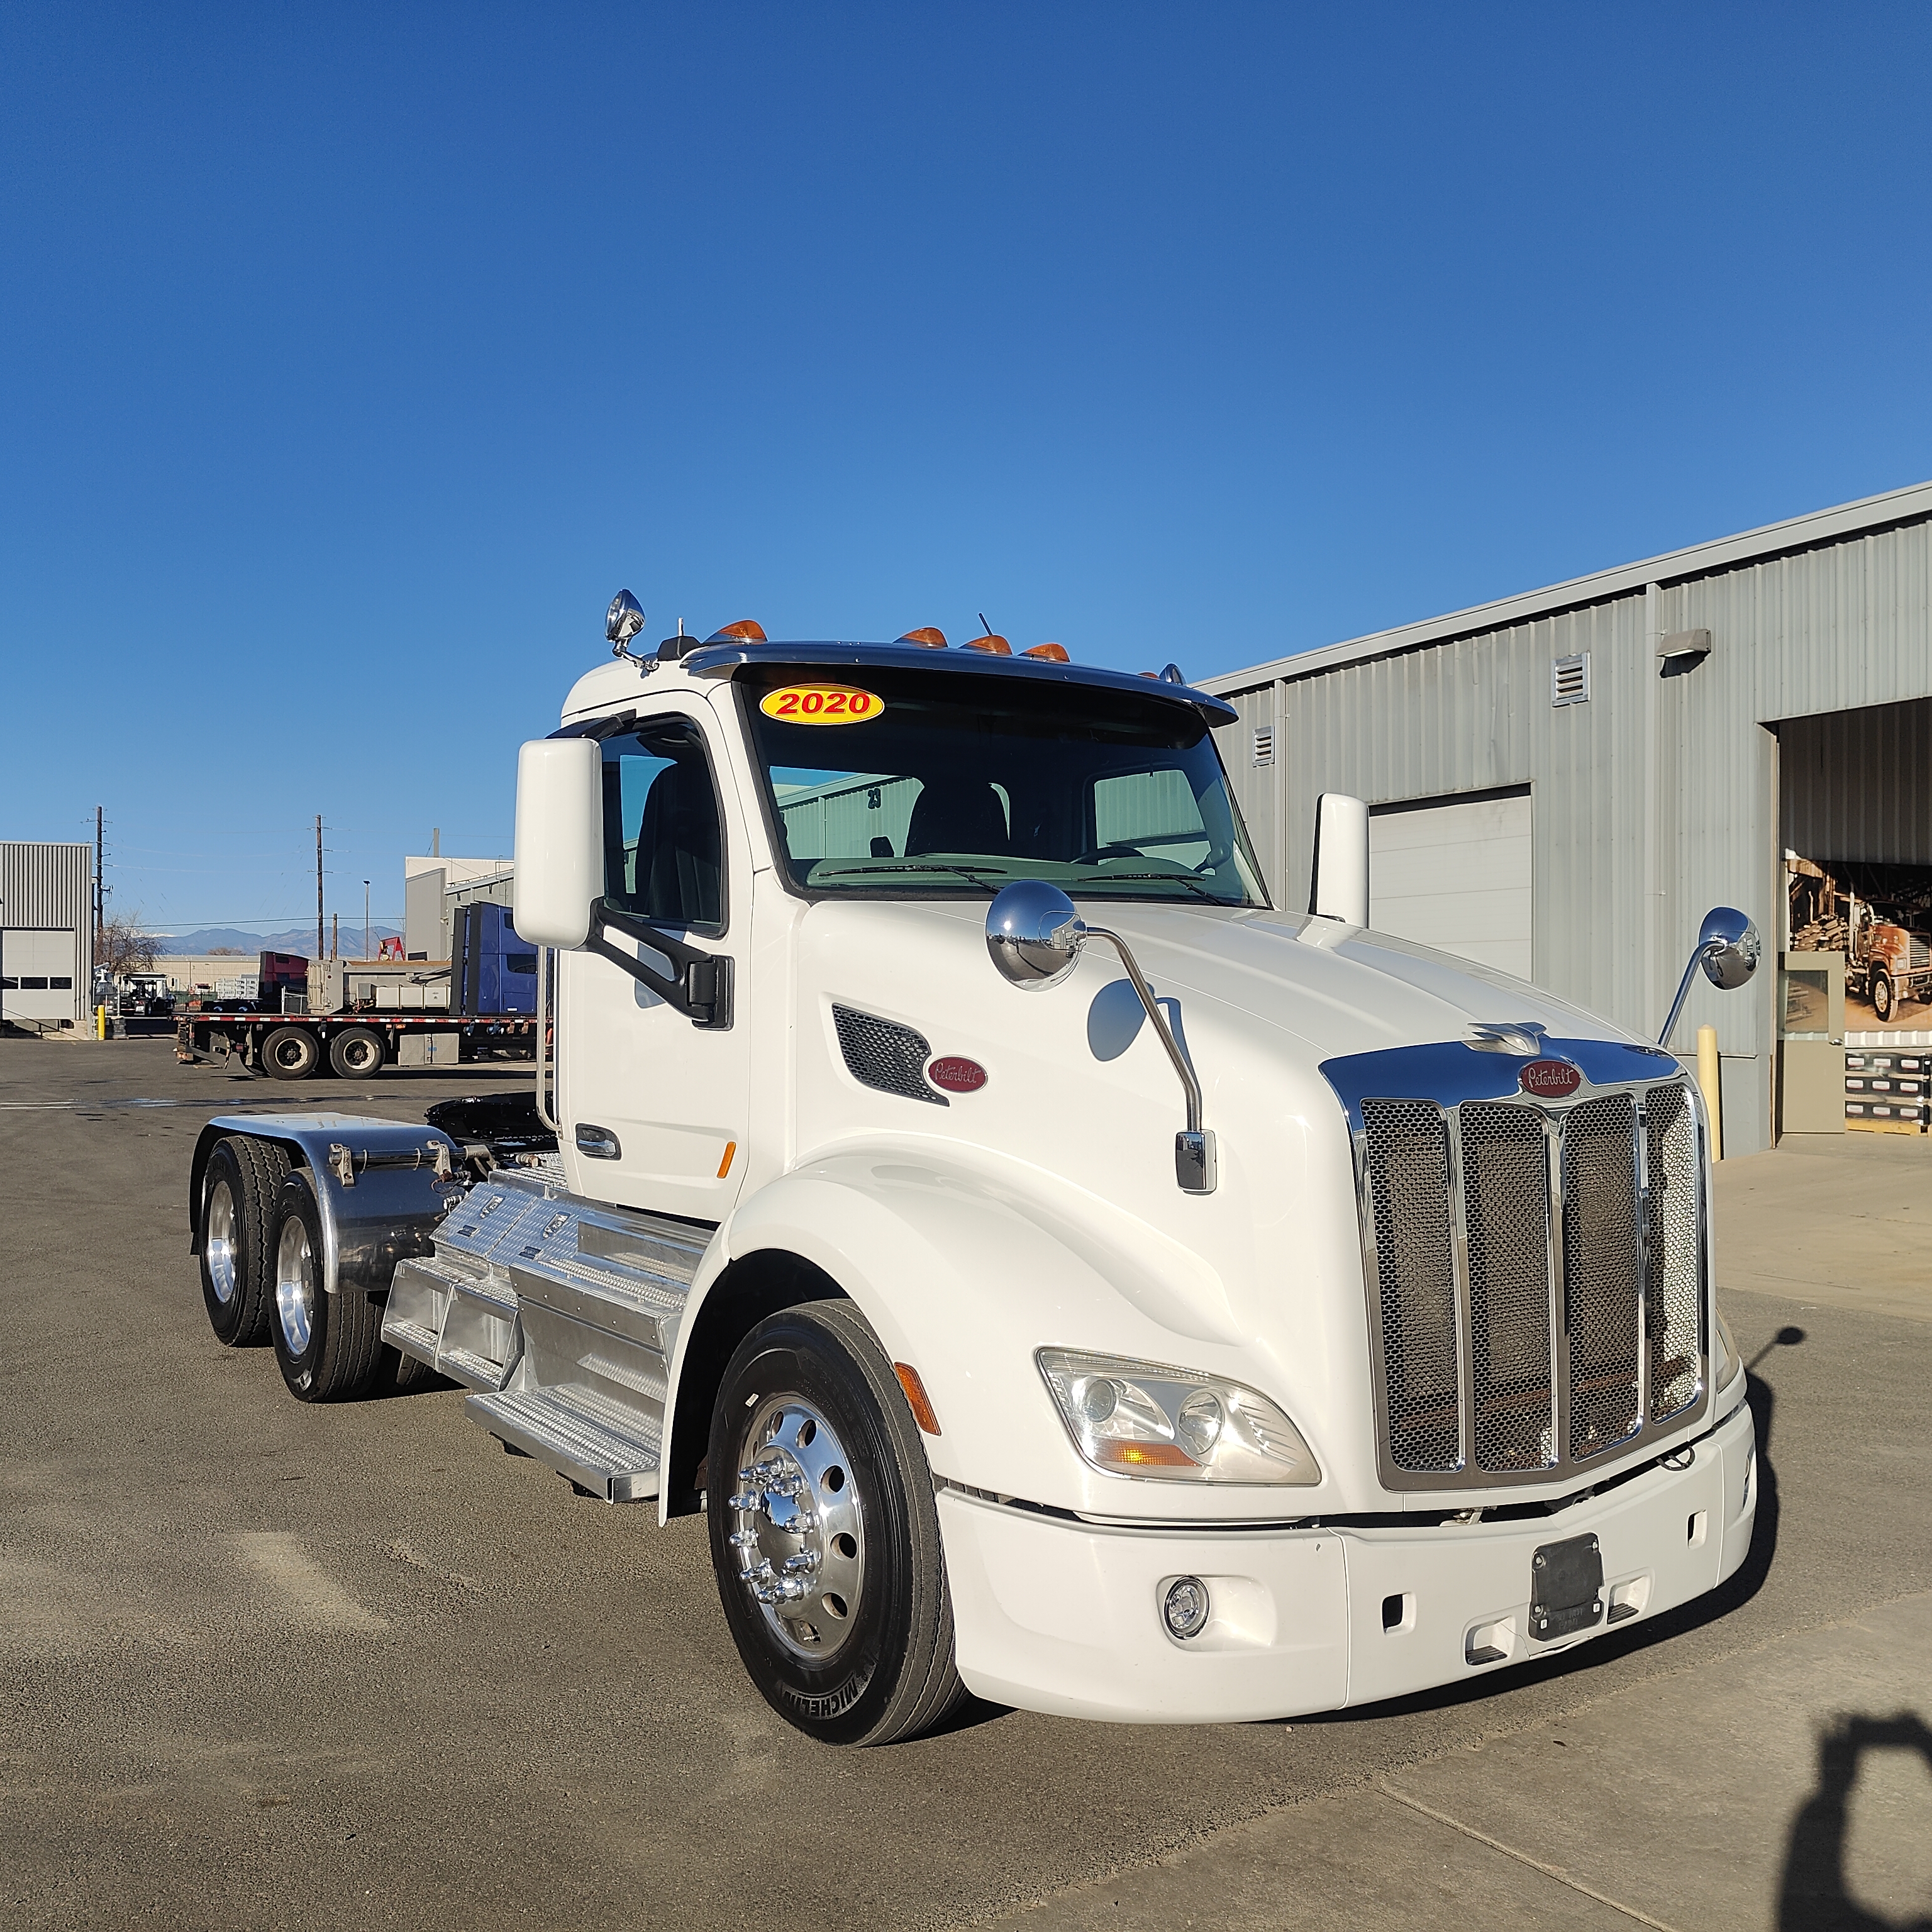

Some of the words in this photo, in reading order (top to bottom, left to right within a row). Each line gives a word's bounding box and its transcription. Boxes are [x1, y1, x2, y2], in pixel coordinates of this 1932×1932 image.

[775, 693, 871, 716] 2020
[867, 788, 881, 809] 23
[935, 1062, 981, 1084] Peterbilt
[1528, 1067, 1574, 1088] Peterbilt
[782, 1675, 859, 1718] MICHELIN
